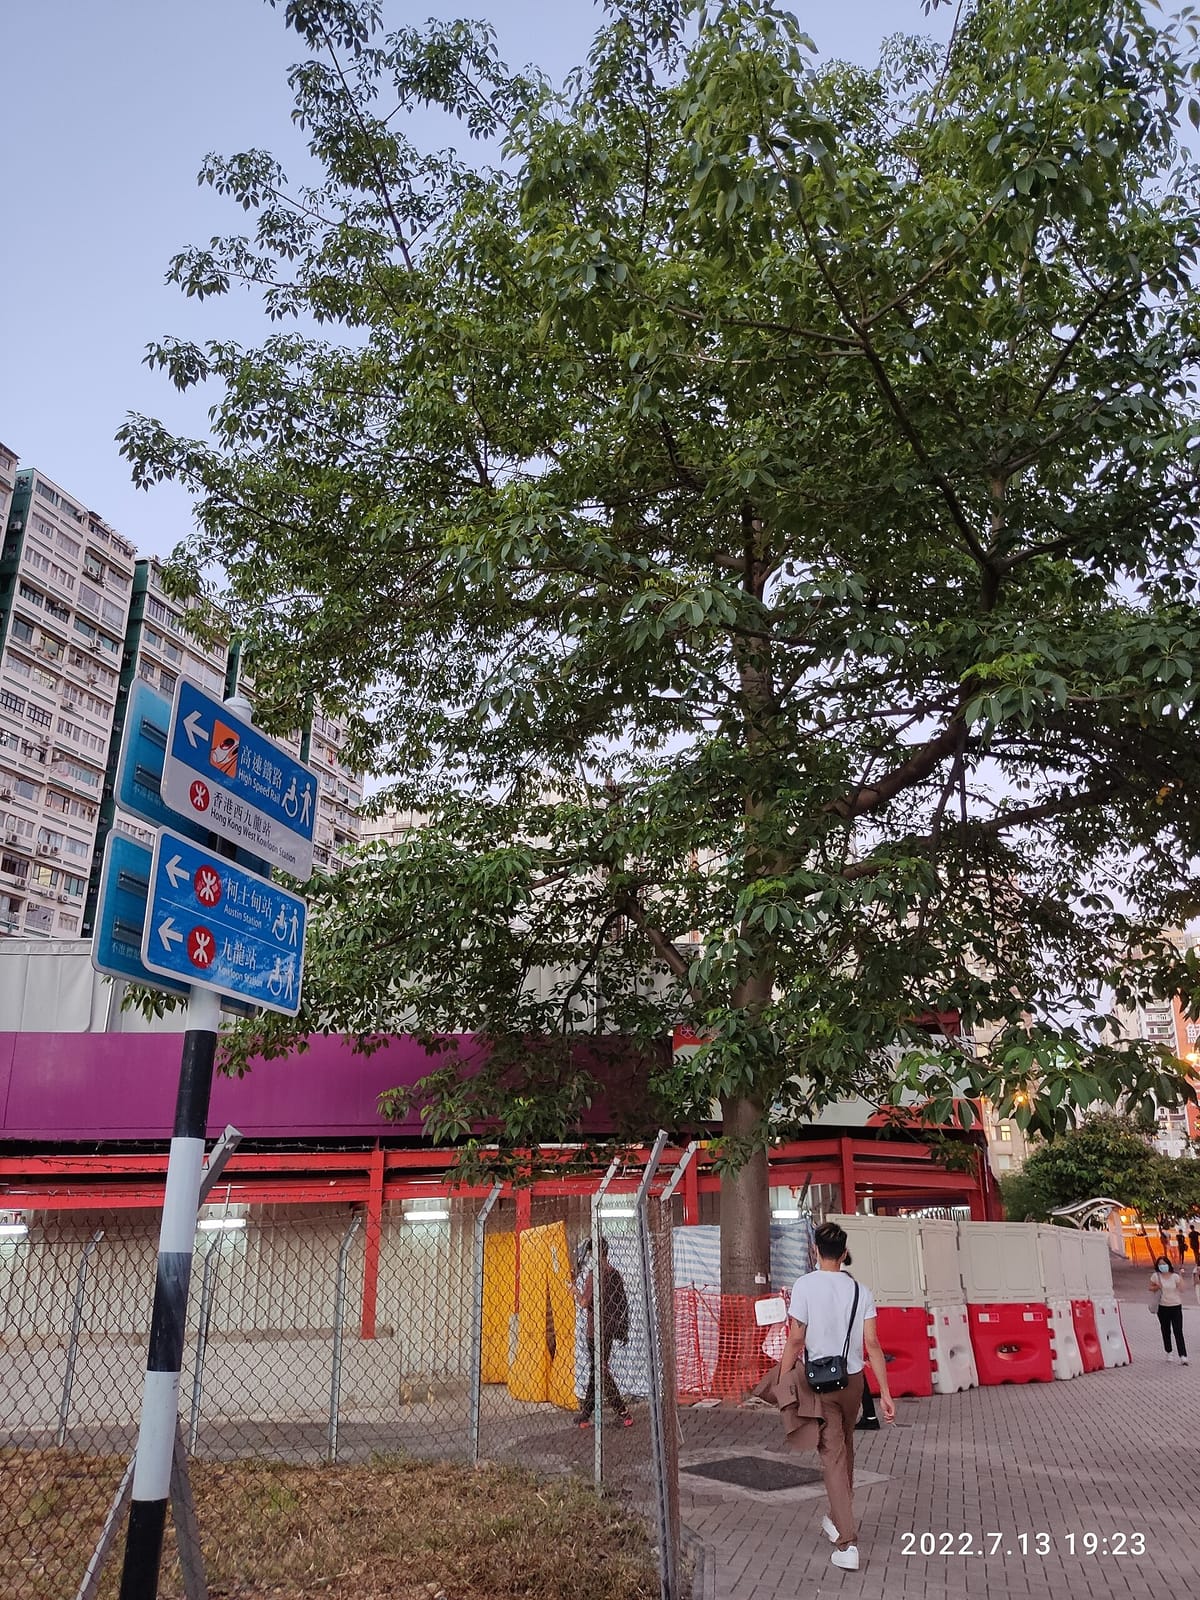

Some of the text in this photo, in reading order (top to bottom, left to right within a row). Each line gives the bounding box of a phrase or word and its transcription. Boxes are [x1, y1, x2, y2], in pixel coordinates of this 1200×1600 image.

[238, 768, 281, 804] High Speed Rail
[240, 746, 283, 789] 高速鐵路
[212, 791, 271, 837] 香港西九龍站
[210, 807, 296, 863] Hong Kong West Kowloon Station
[224, 904, 262, 928] Austin Station
[226, 877, 272, 918] 柯士甸站
[221, 937, 257, 970] 九龍站
[243, 972, 263, 987] Station
